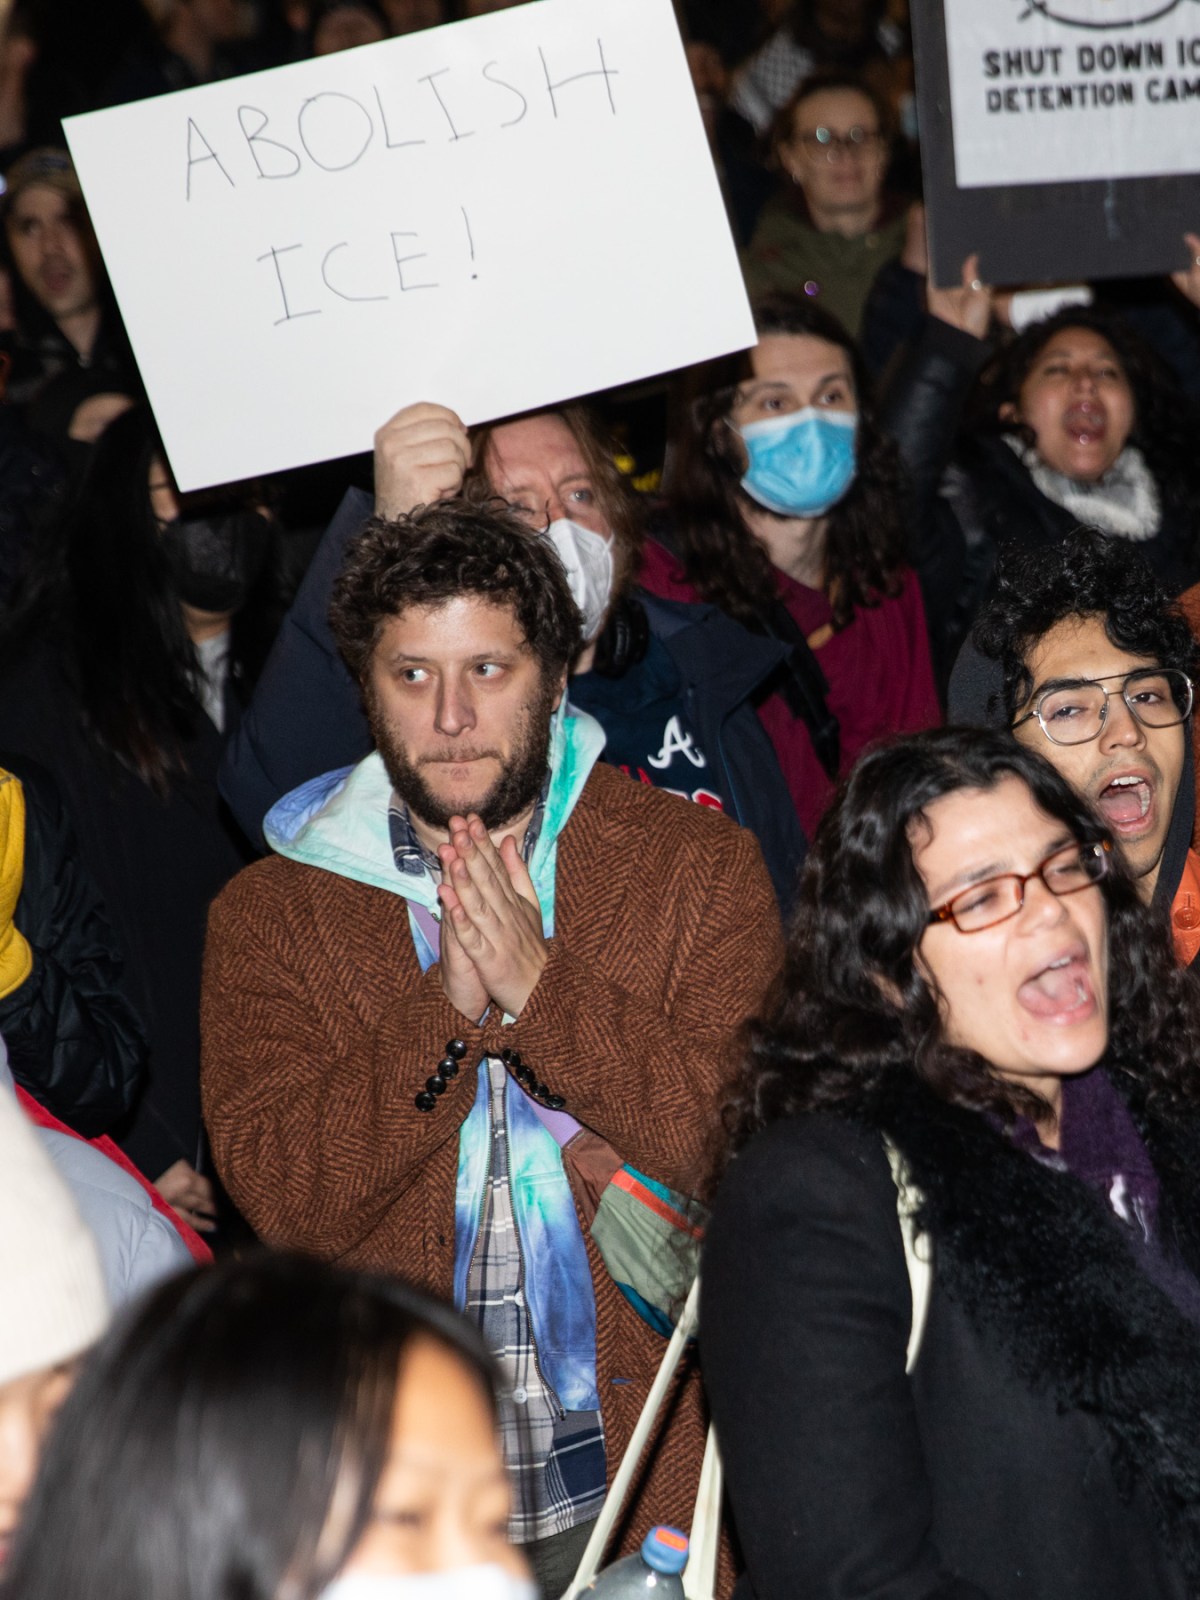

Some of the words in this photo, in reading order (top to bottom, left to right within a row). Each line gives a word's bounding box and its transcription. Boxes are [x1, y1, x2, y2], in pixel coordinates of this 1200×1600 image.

[984, 48, 1062, 78] SHUT
[1077, 41, 1164, 73] DOWN
[186, 39, 619, 202] ABOLISH
[985, 81, 1135, 113] DETENTION
[257, 206, 479, 327] ICE!
[647, 715, 706, 769] A
